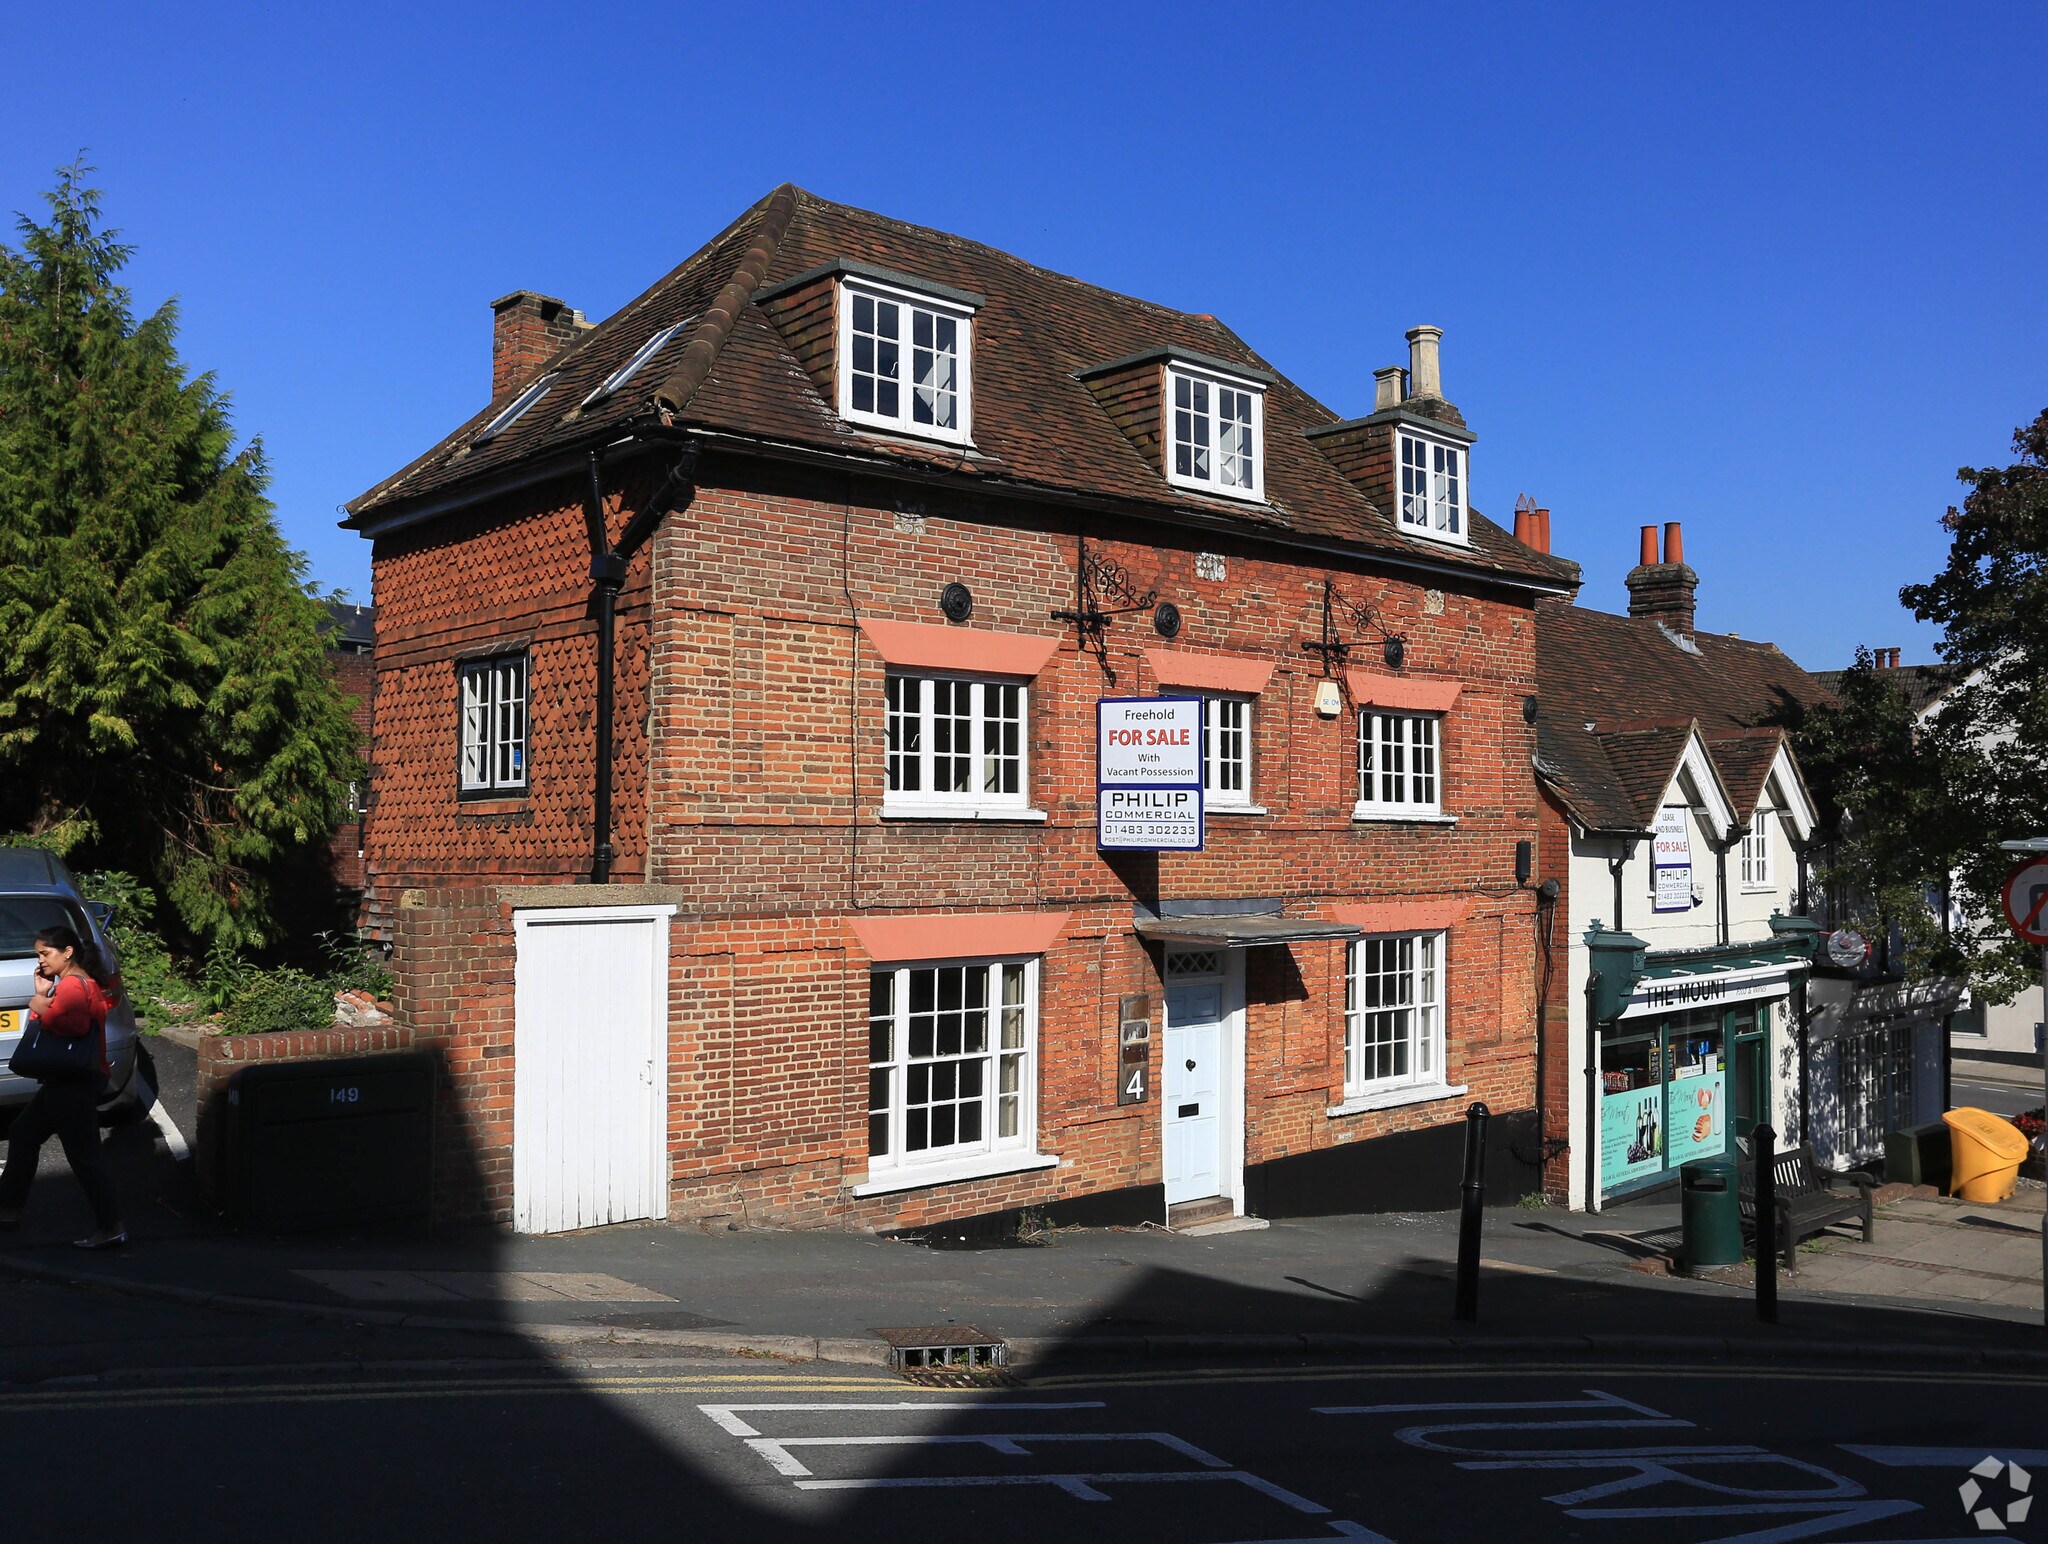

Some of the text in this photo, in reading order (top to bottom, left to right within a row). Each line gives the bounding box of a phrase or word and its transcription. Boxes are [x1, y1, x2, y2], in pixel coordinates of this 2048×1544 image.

[1124, 708, 1175, 721] Freehold
[1108, 728, 1190, 746] FOR SALE
[1137, 753, 1161, 763] With
[1106, 767, 1194, 777] Vacant Possession
[1112, 792, 1188, 807] PHILIP
[1105, 810, 1195, 819] COMMERCIAL
[1662, 813, 1675, 821] LEASE
[1104, 824, 1196, 836] 01483 302233
[1655, 825, 1684, 833] AND BUSINESS
[1656, 841, 1688, 853] FOR SALE
[1660, 869, 1688, 881] PHILIP
[1647, 984, 1674, 1009] THE
[1679, 979, 1727, 1004] MOUNT
[1126, 1069, 1144, 1099] 4
[330, 1088, 359, 1103] 149
